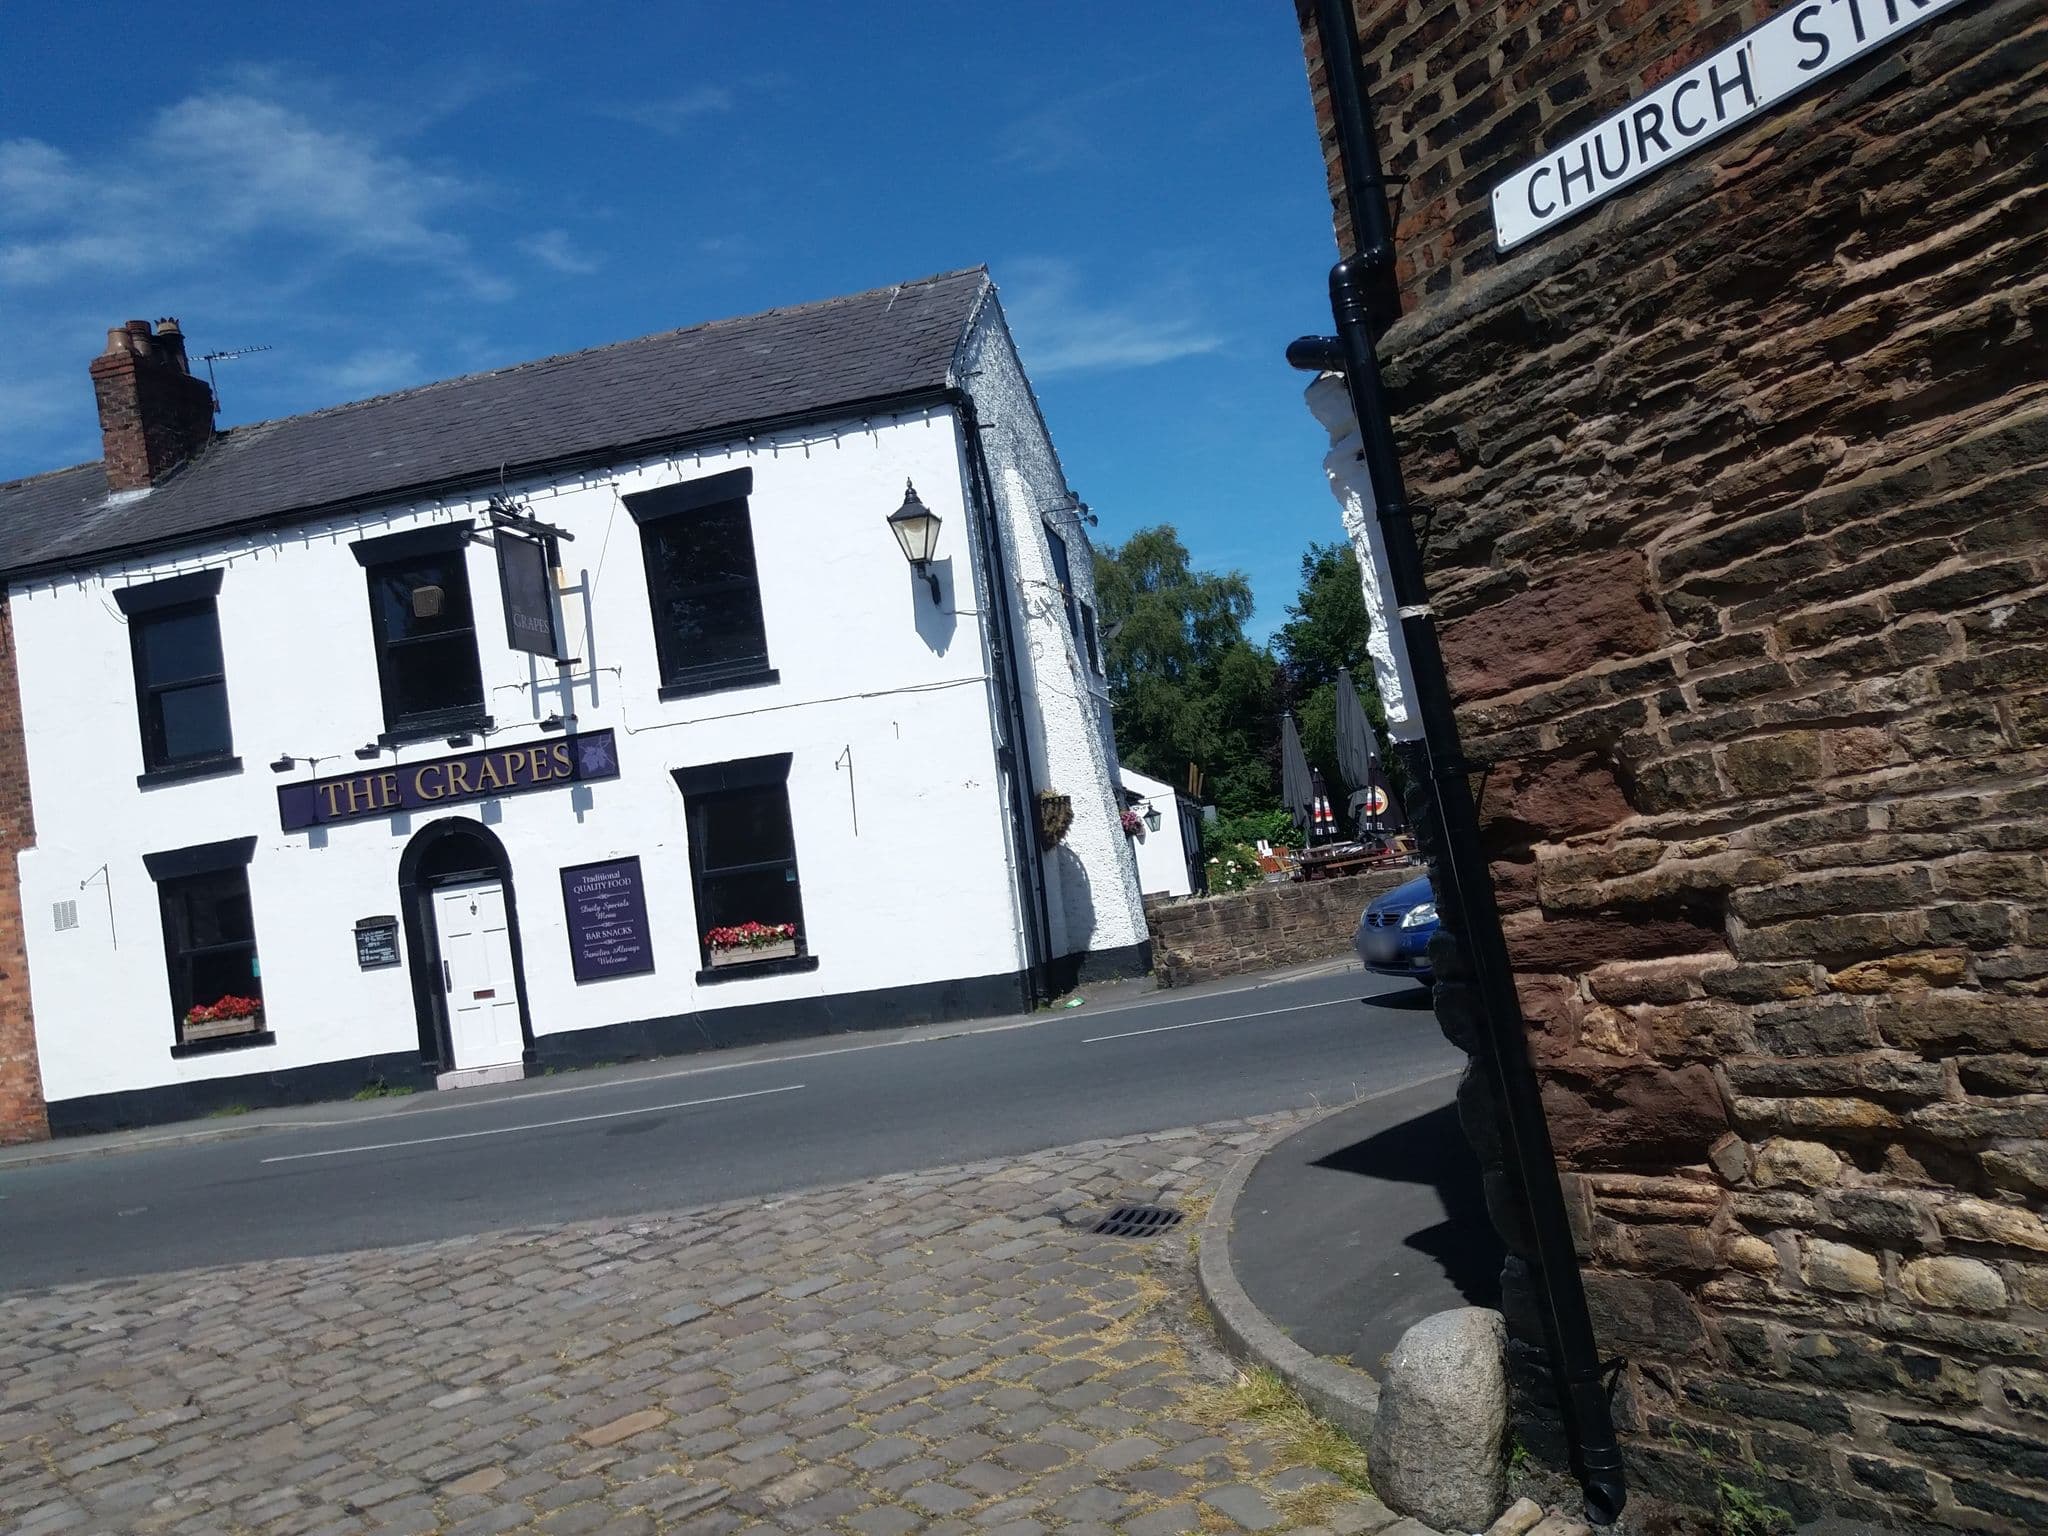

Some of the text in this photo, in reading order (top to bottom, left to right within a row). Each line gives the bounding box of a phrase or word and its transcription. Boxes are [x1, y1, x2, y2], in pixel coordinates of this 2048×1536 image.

[1526, 47, 1755, 219] CHURCH
[514, 613, 550, 633] GRAPES
[319, 743, 574, 818] THE GRAPES
[574, 878, 631, 894] QUALITY FOOD
[582, 871, 620, 883] Traditional
[585, 927, 632, 941] BAR SNACKS
